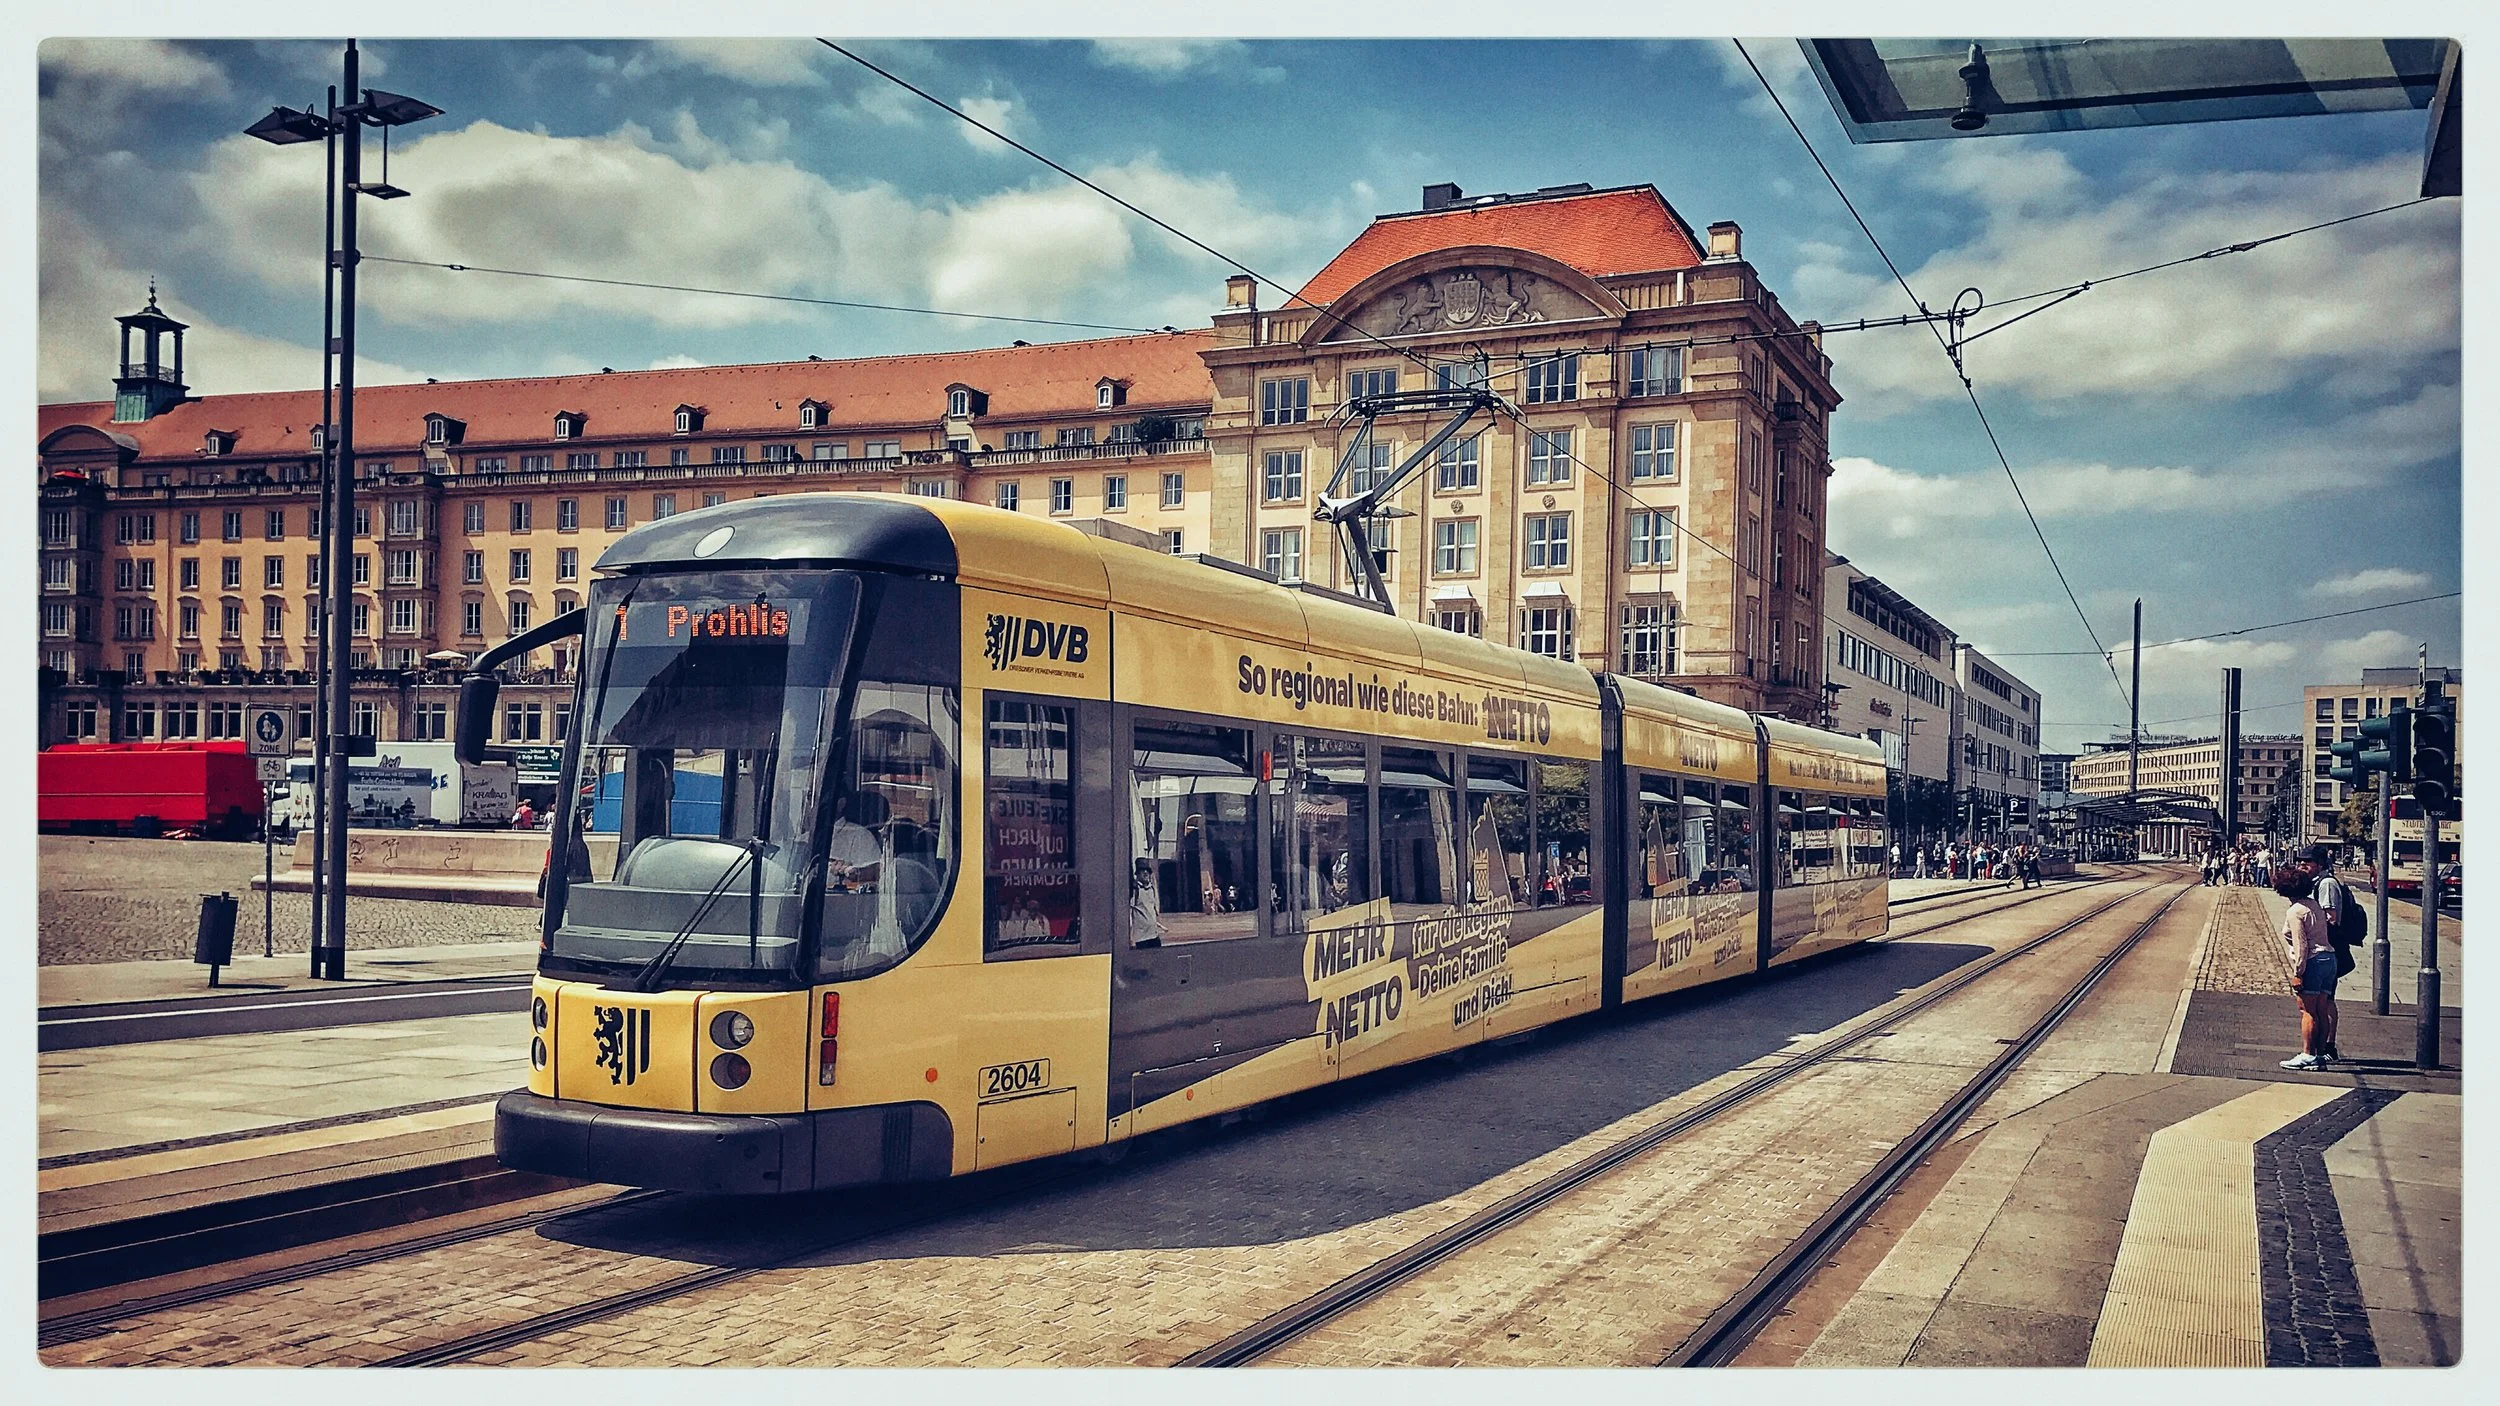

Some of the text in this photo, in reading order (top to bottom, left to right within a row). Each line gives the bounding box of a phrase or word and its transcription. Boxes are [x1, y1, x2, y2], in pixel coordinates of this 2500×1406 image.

[615, 603, 788, 640] 1 Prohlis
[1021, 619, 1089, 663] DVB
[1238, 655, 1550, 746] So regional wie diese Bahn: NETTO
[259, 744, 280, 753] ZONE
[1313, 915, 1385, 982] MEHR
[1413, 915, 1438, 958] für
[1440, 905, 1462, 948] die
[1660, 928, 1692, 971] NETTO
[1420, 931, 1508, 1000] Deine Familie
[1325, 975, 1402, 1050] NETTO
[1454, 972, 1513, 1027] und Dich!
[988, 1062, 1041, 1094] 2604
